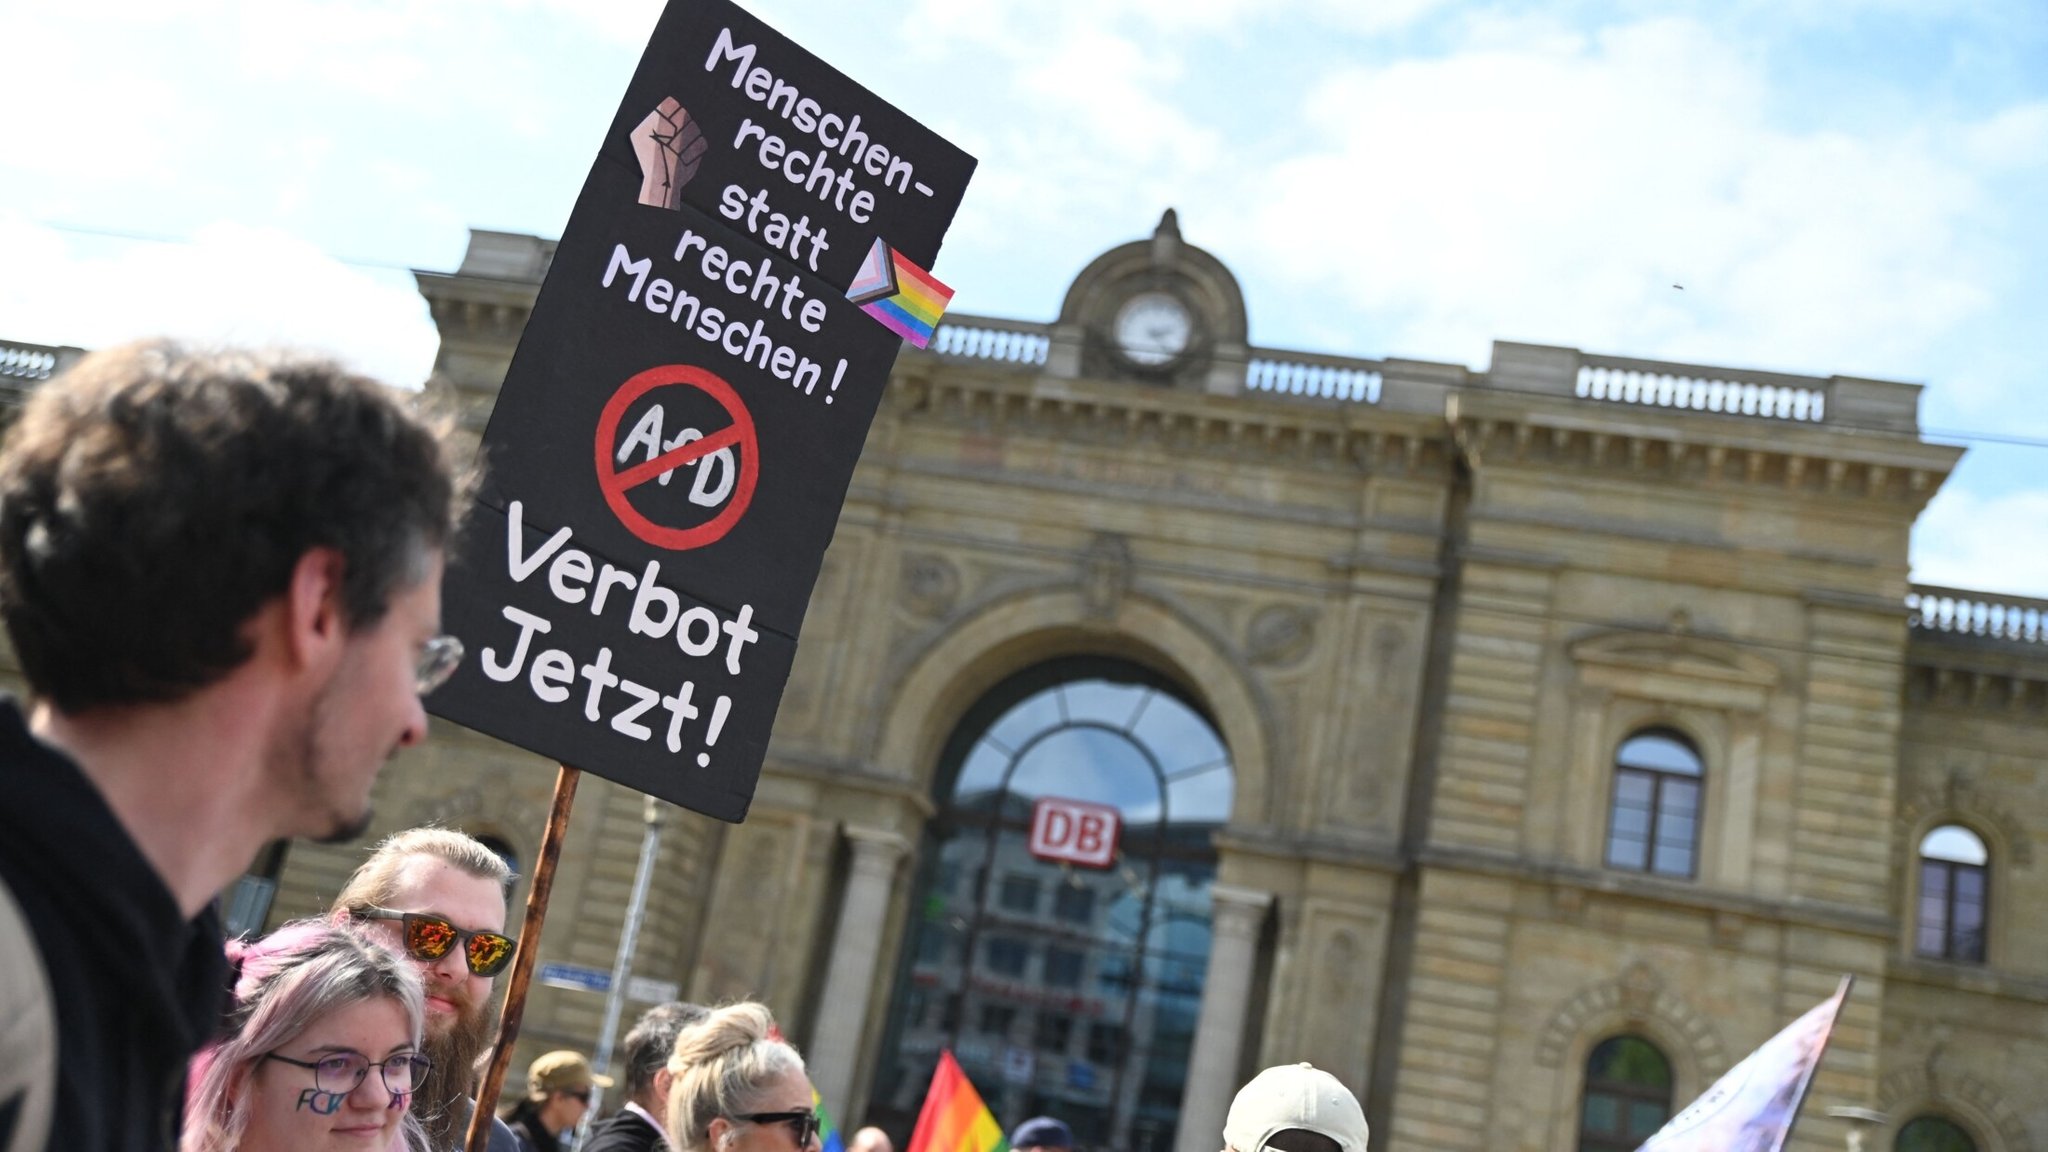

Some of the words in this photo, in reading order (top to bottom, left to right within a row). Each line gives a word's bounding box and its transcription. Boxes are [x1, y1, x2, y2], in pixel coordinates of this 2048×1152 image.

[704, 27, 934, 197] Menschen-
[733, 118, 875, 224] rechte
[673, 229, 827, 333] rechte
[718, 184, 830, 273] statt
[616, 404, 735, 507] AfD
[508, 501, 758, 675] Verbot
[481, 606, 731, 767] Jetzt!
[1043, 809, 1105, 853] DB
